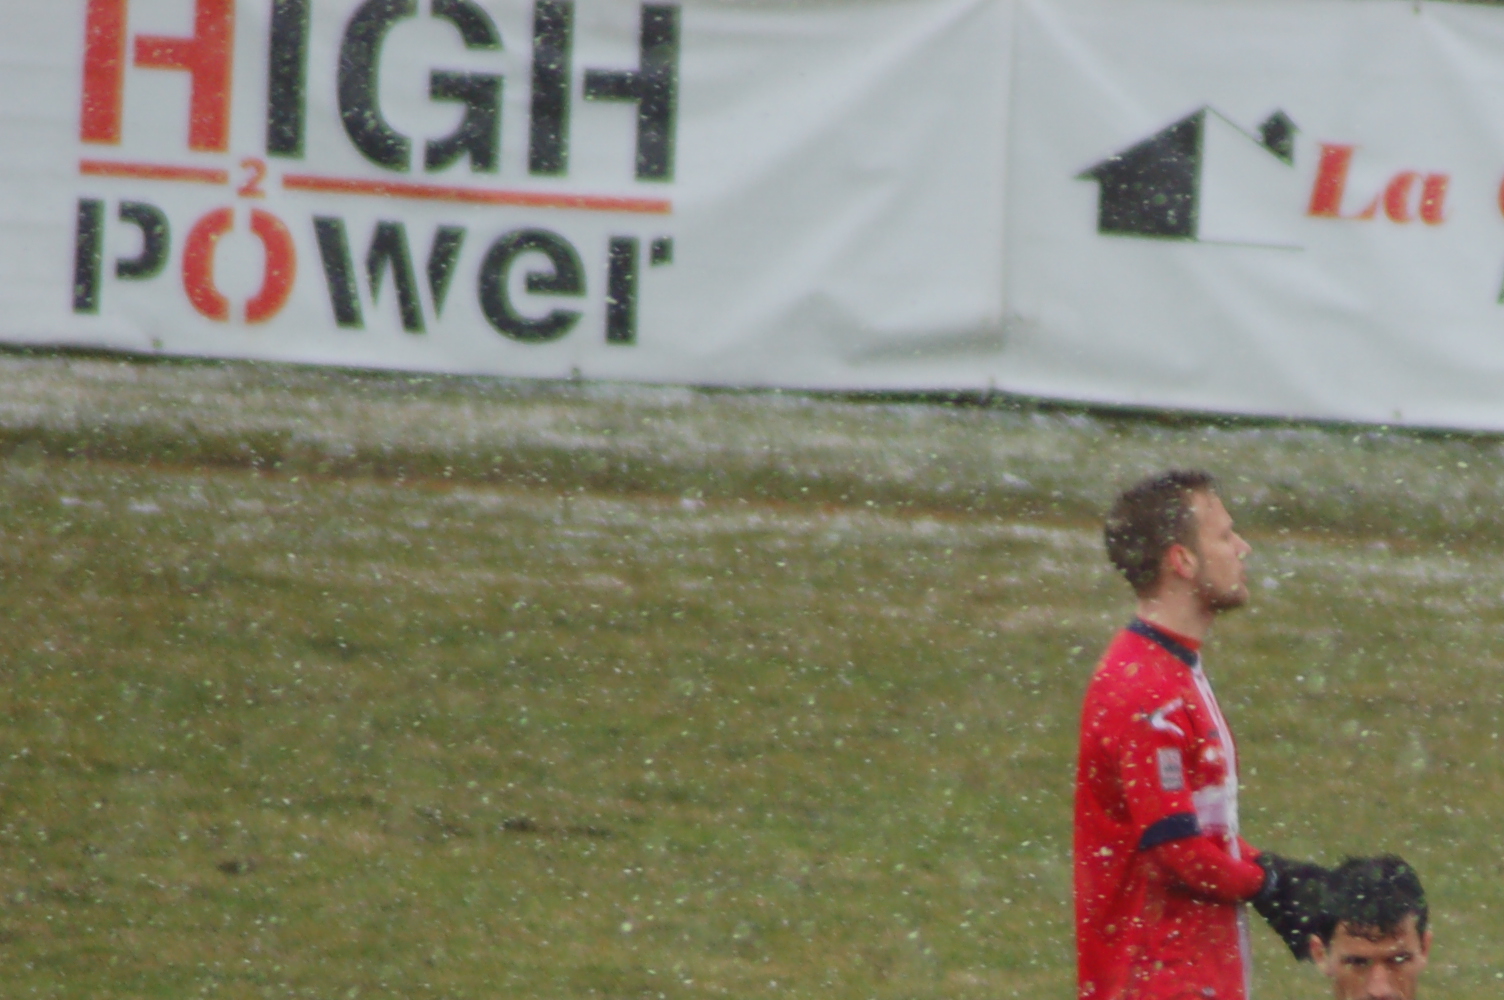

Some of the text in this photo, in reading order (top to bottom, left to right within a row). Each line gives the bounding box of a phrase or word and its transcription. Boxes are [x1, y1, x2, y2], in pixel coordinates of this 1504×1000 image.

[79, 0, 681, 183] HIGH
[237, 159, 268, 199] 2
[1305, 143, 1452, 227] La
